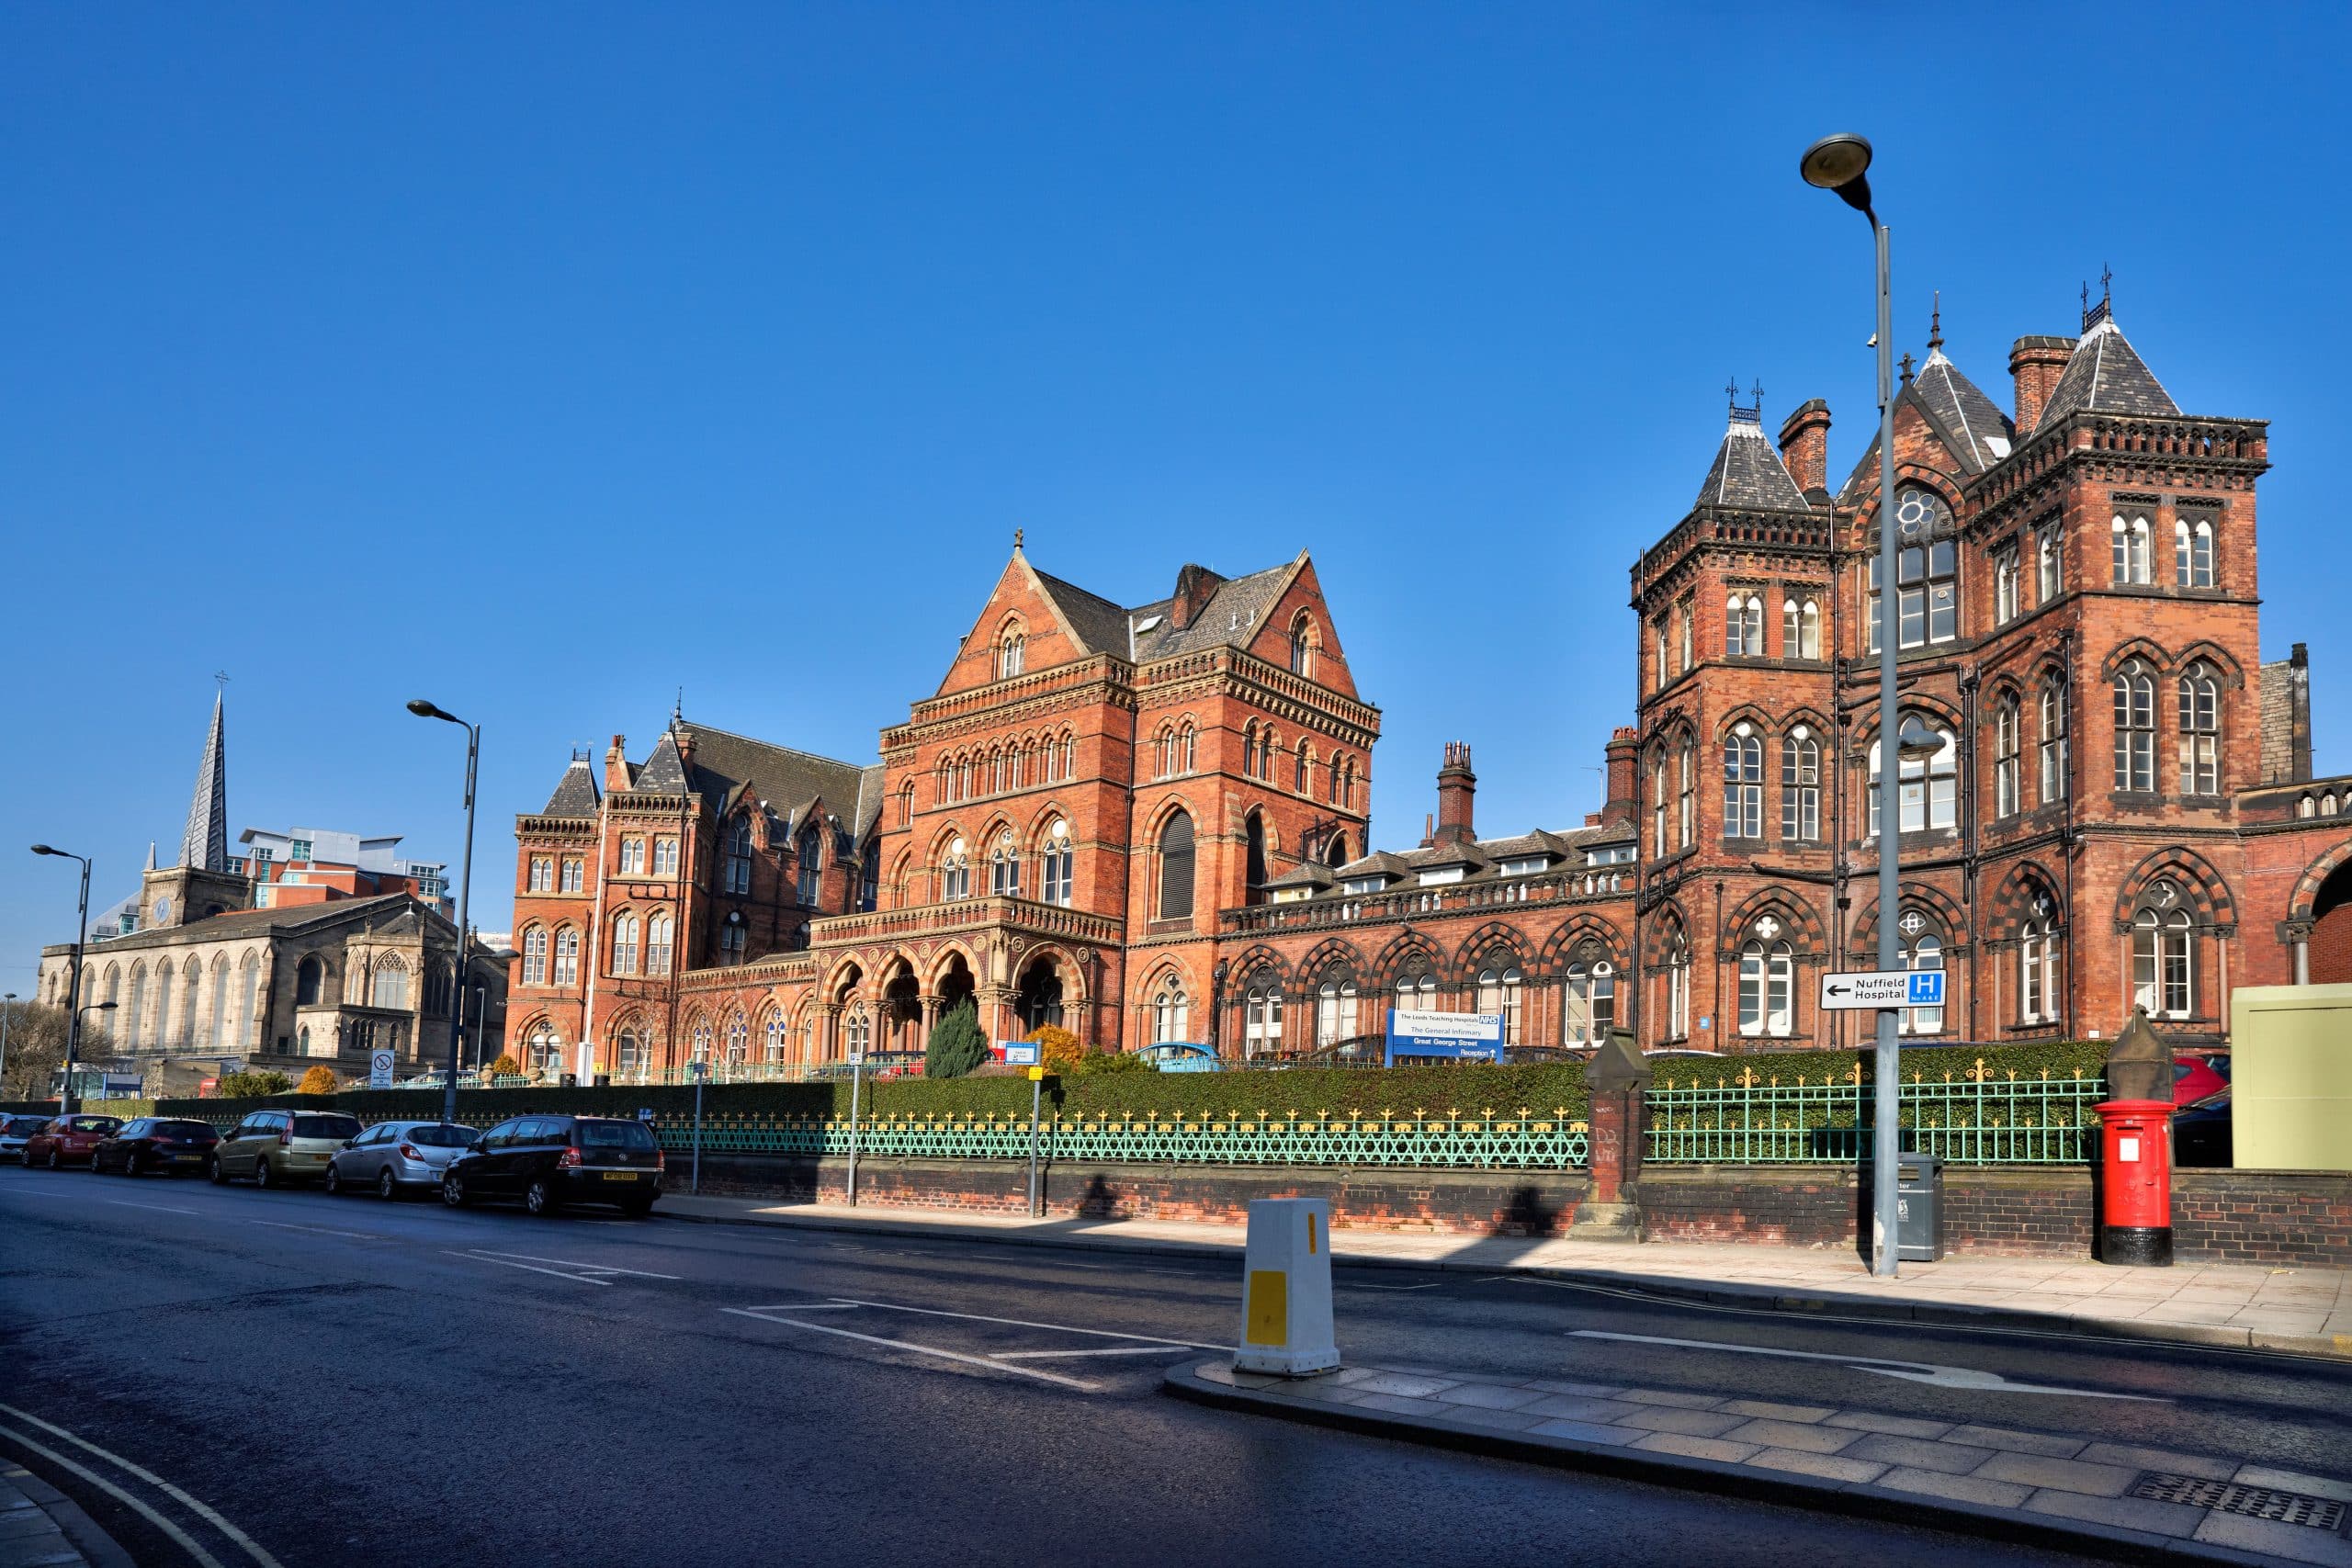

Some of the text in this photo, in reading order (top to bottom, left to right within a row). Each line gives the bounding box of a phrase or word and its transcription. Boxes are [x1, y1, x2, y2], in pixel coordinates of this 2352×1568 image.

[1856, 978, 1905, 988] Nuffield
[1917, 976, 1934, 993] H
[1855, 989, 1905, 999] Hospital
[1480, 1016, 1498, 1024] NHS
[1460, 1049, 1488, 1057] Reception
